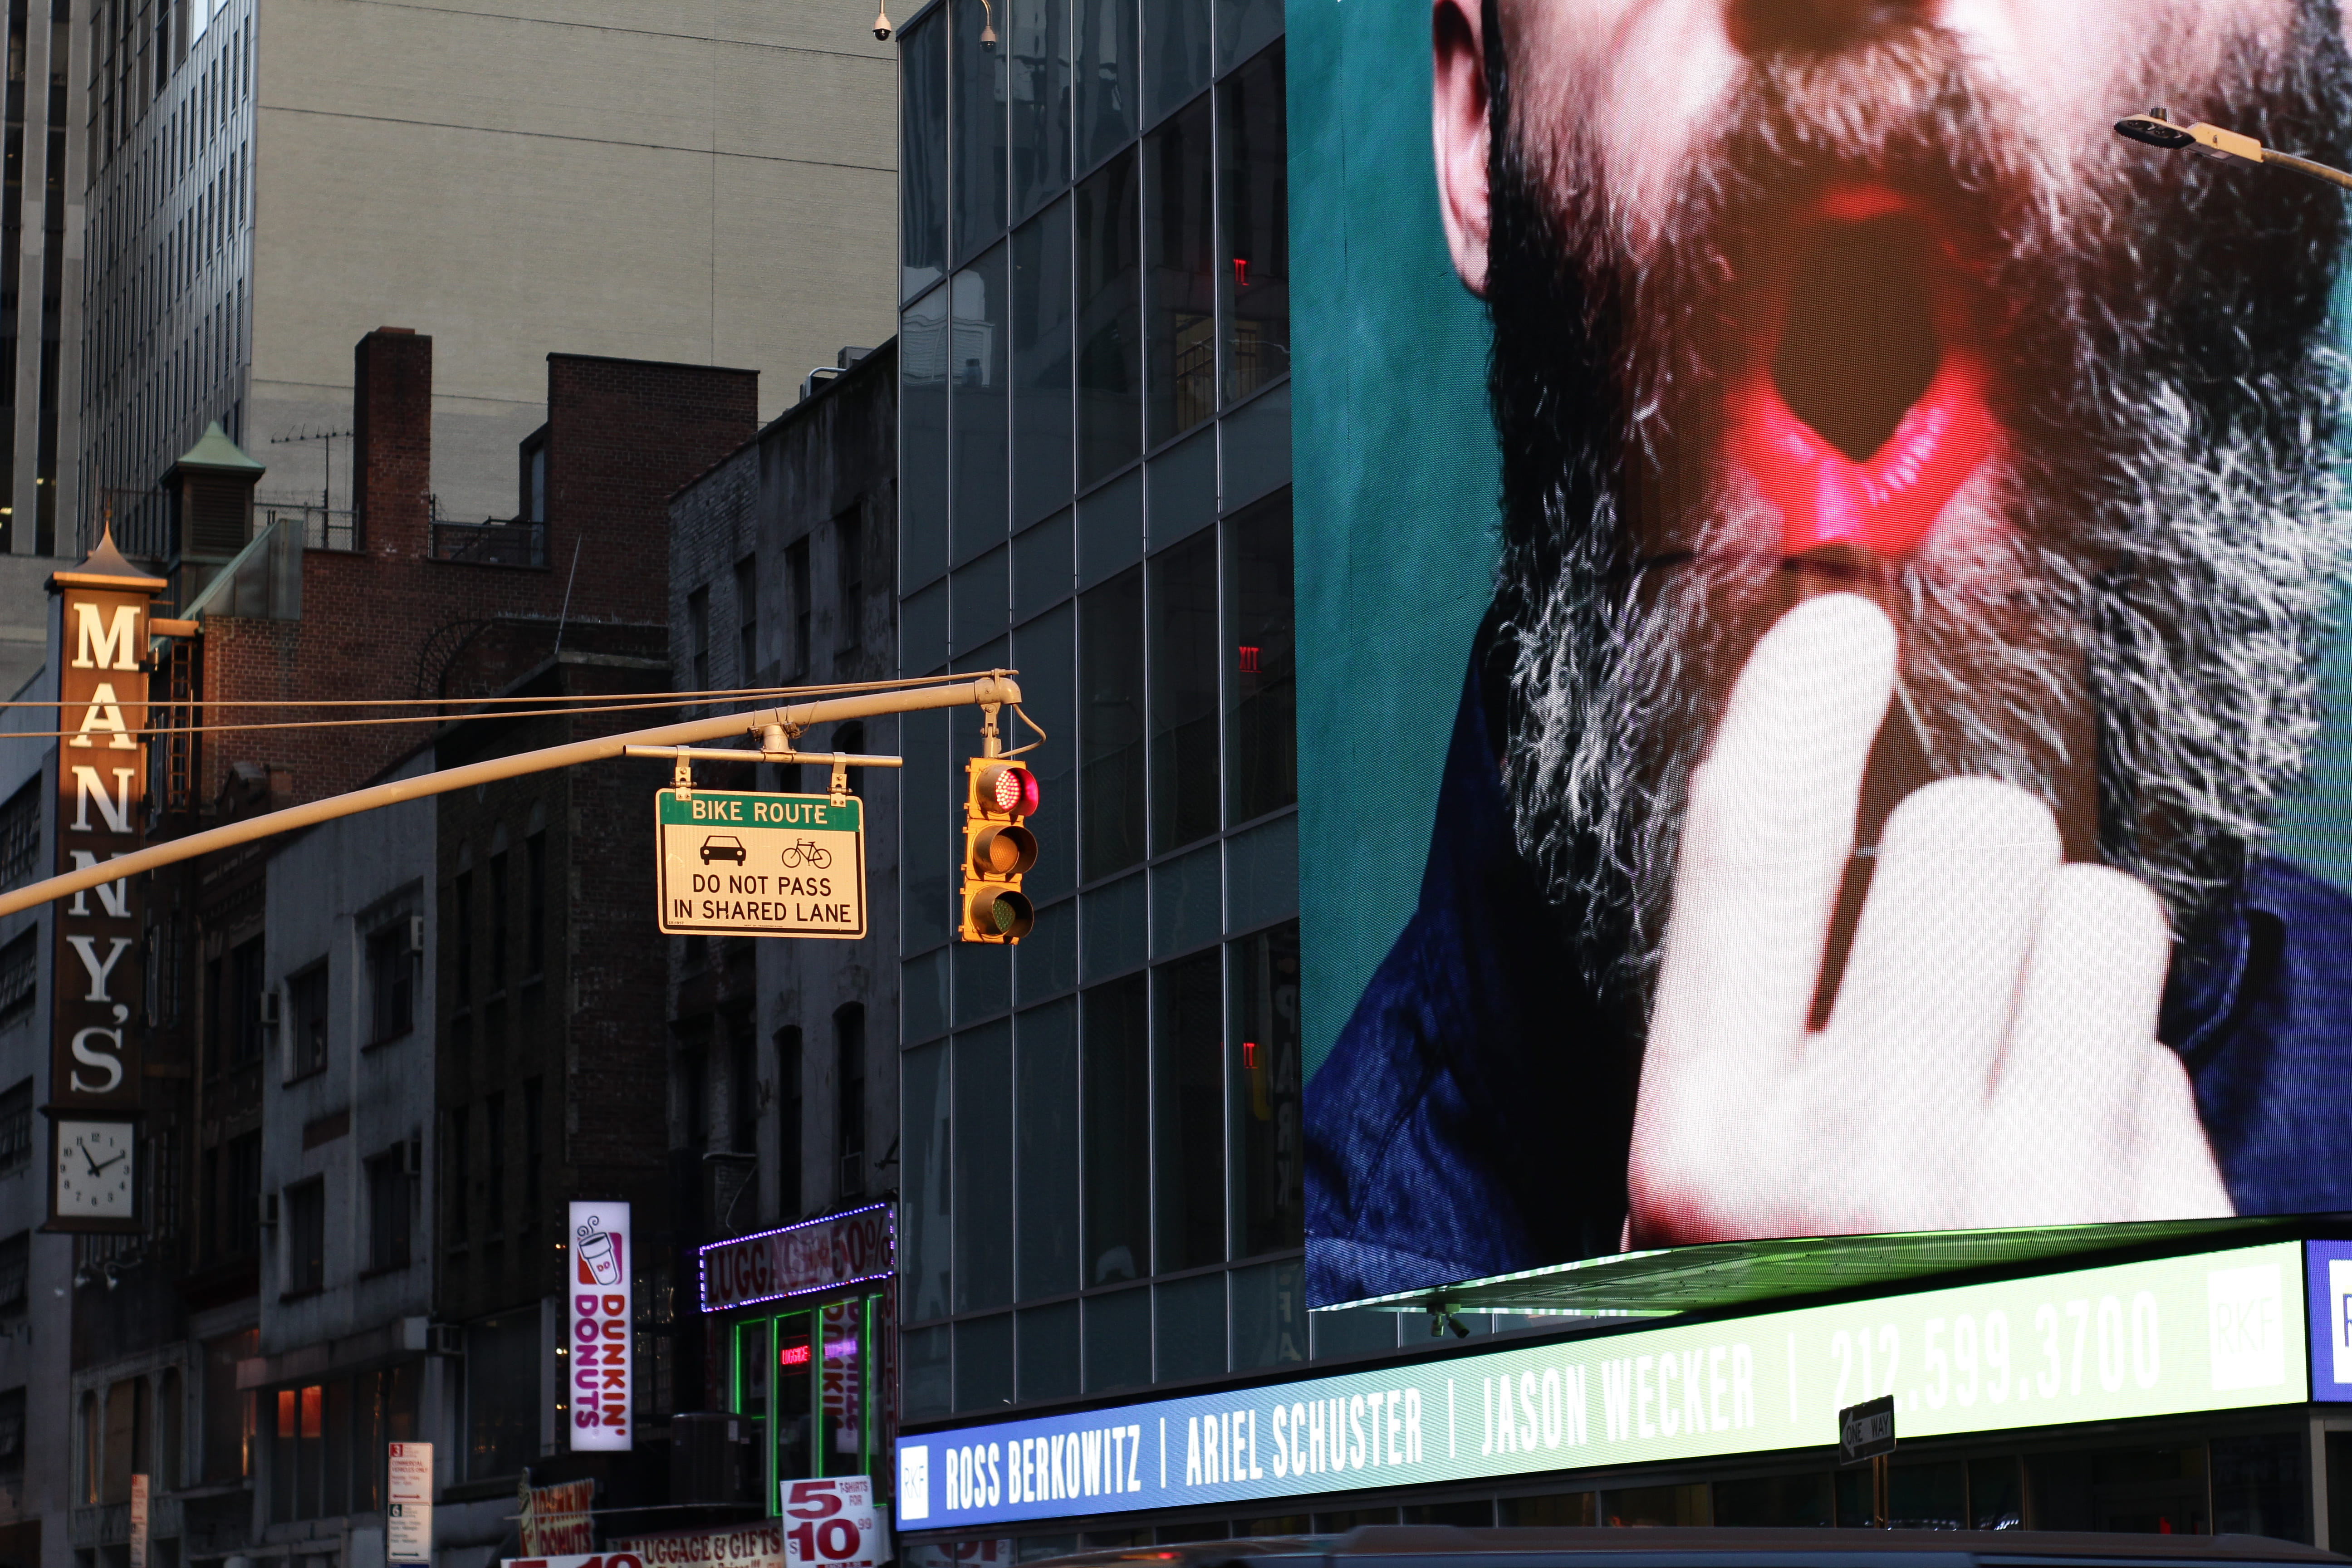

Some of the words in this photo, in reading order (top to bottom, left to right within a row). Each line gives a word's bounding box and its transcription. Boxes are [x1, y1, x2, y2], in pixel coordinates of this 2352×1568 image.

[693, 800, 743, 821] BIKE
[754, 802, 828, 824] ROUTE
[693, 874, 720, 893] DO
[730, 875, 768, 895] NOT
[779, 877, 831, 897] PASS
[674, 899, 692, 918] IN
[703, 900, 786, 921] SHARED
[797, 902, 851, 923] LANE
[575, 1294, 599, 1428] DONUTS
[602, 1294, 626, 1436] DUNKIN'
[946, 1442, 1000, 1510] ROSS
[1008, 1425, 1141, 1504] BERKOWITZ
[1186, 1409, 1263, 1486] ARIEL
[1273, 1388, 1422, 1478] SCHUSTER
[1482, 1364, 1587, 1456] JASON
[1601, 1343, 1754, 1442] WECKER
[1831, 1291, 2160, 1418] 212.599.3700
[1846, 1422, 1863, 1445] ONE
[1871, 1413, 1889, 1438] WAY
[393, 1445, 400, 1457] 3
[392, 1504, 400, 1516] 6
[786, 1481, 842, 1519] 5
[840, 1481, 868, 1493] T-SHIRTS
[849, 1495, 862, 1506] FOR
[729, 1528, 781, 1560] GIFTS
